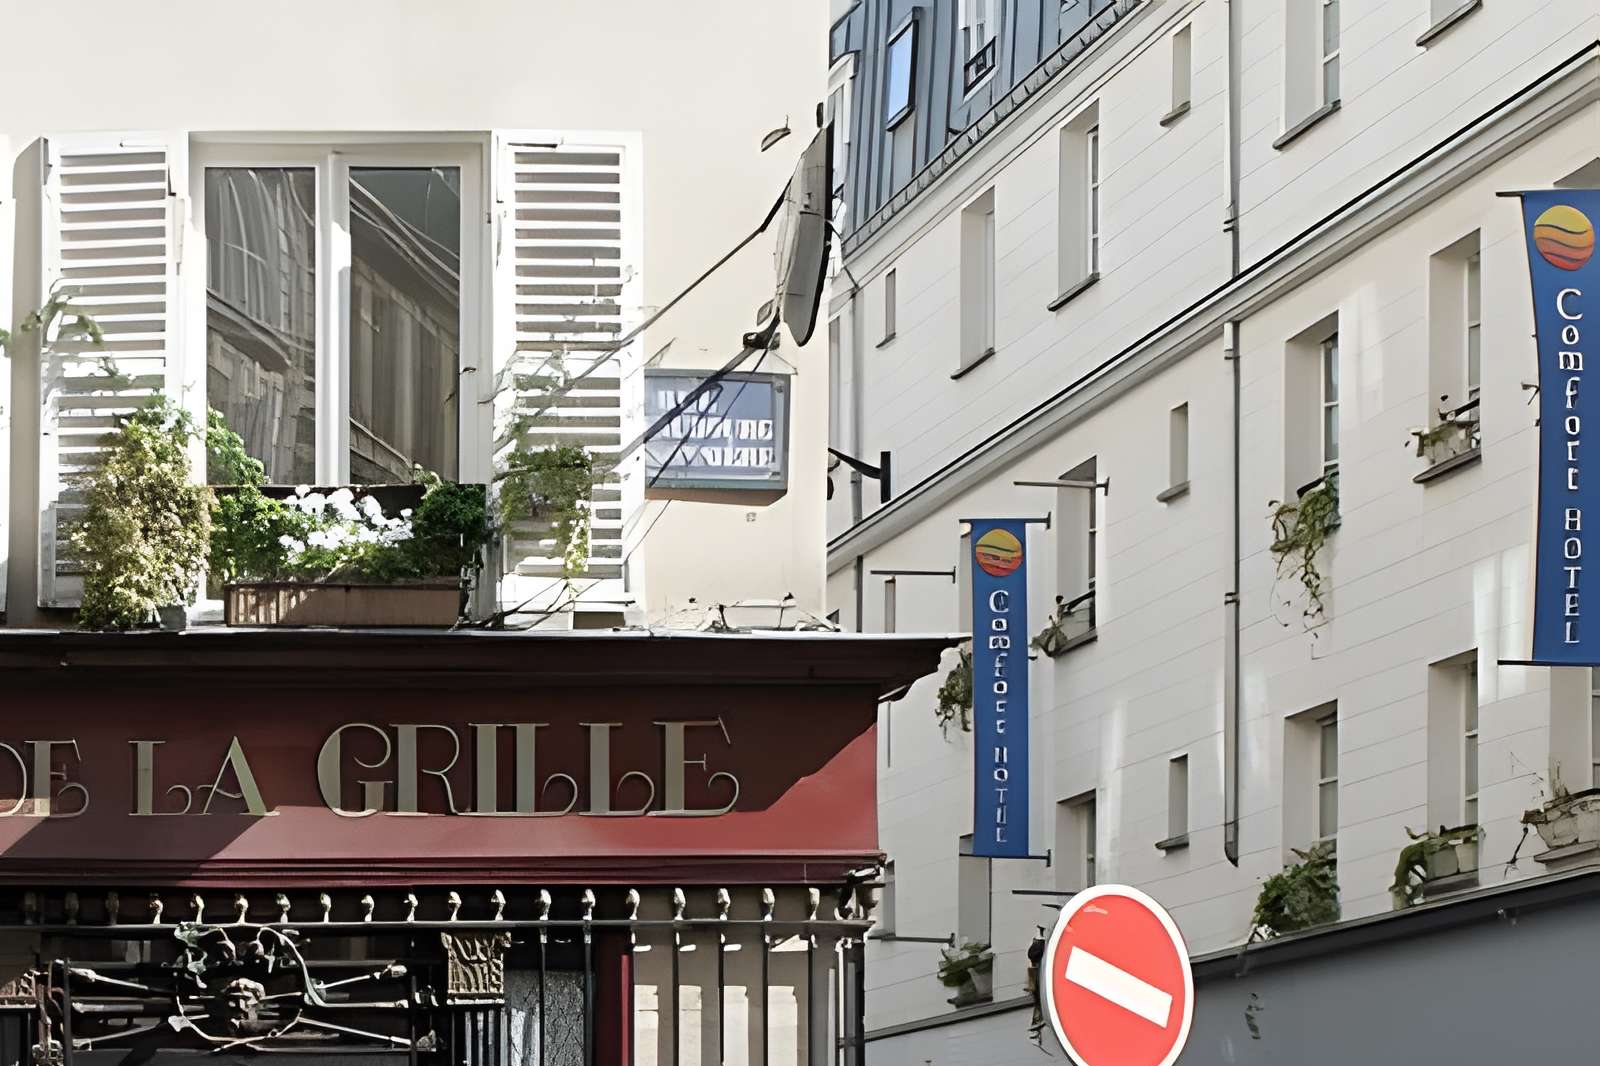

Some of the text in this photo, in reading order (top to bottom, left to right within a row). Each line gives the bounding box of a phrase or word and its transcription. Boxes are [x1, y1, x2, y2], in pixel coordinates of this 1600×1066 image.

[1562, 507, 1583, 645] HOTEL
[127, 735, 280, 817] LA
[316, 714, 740, 818] GRILLE
